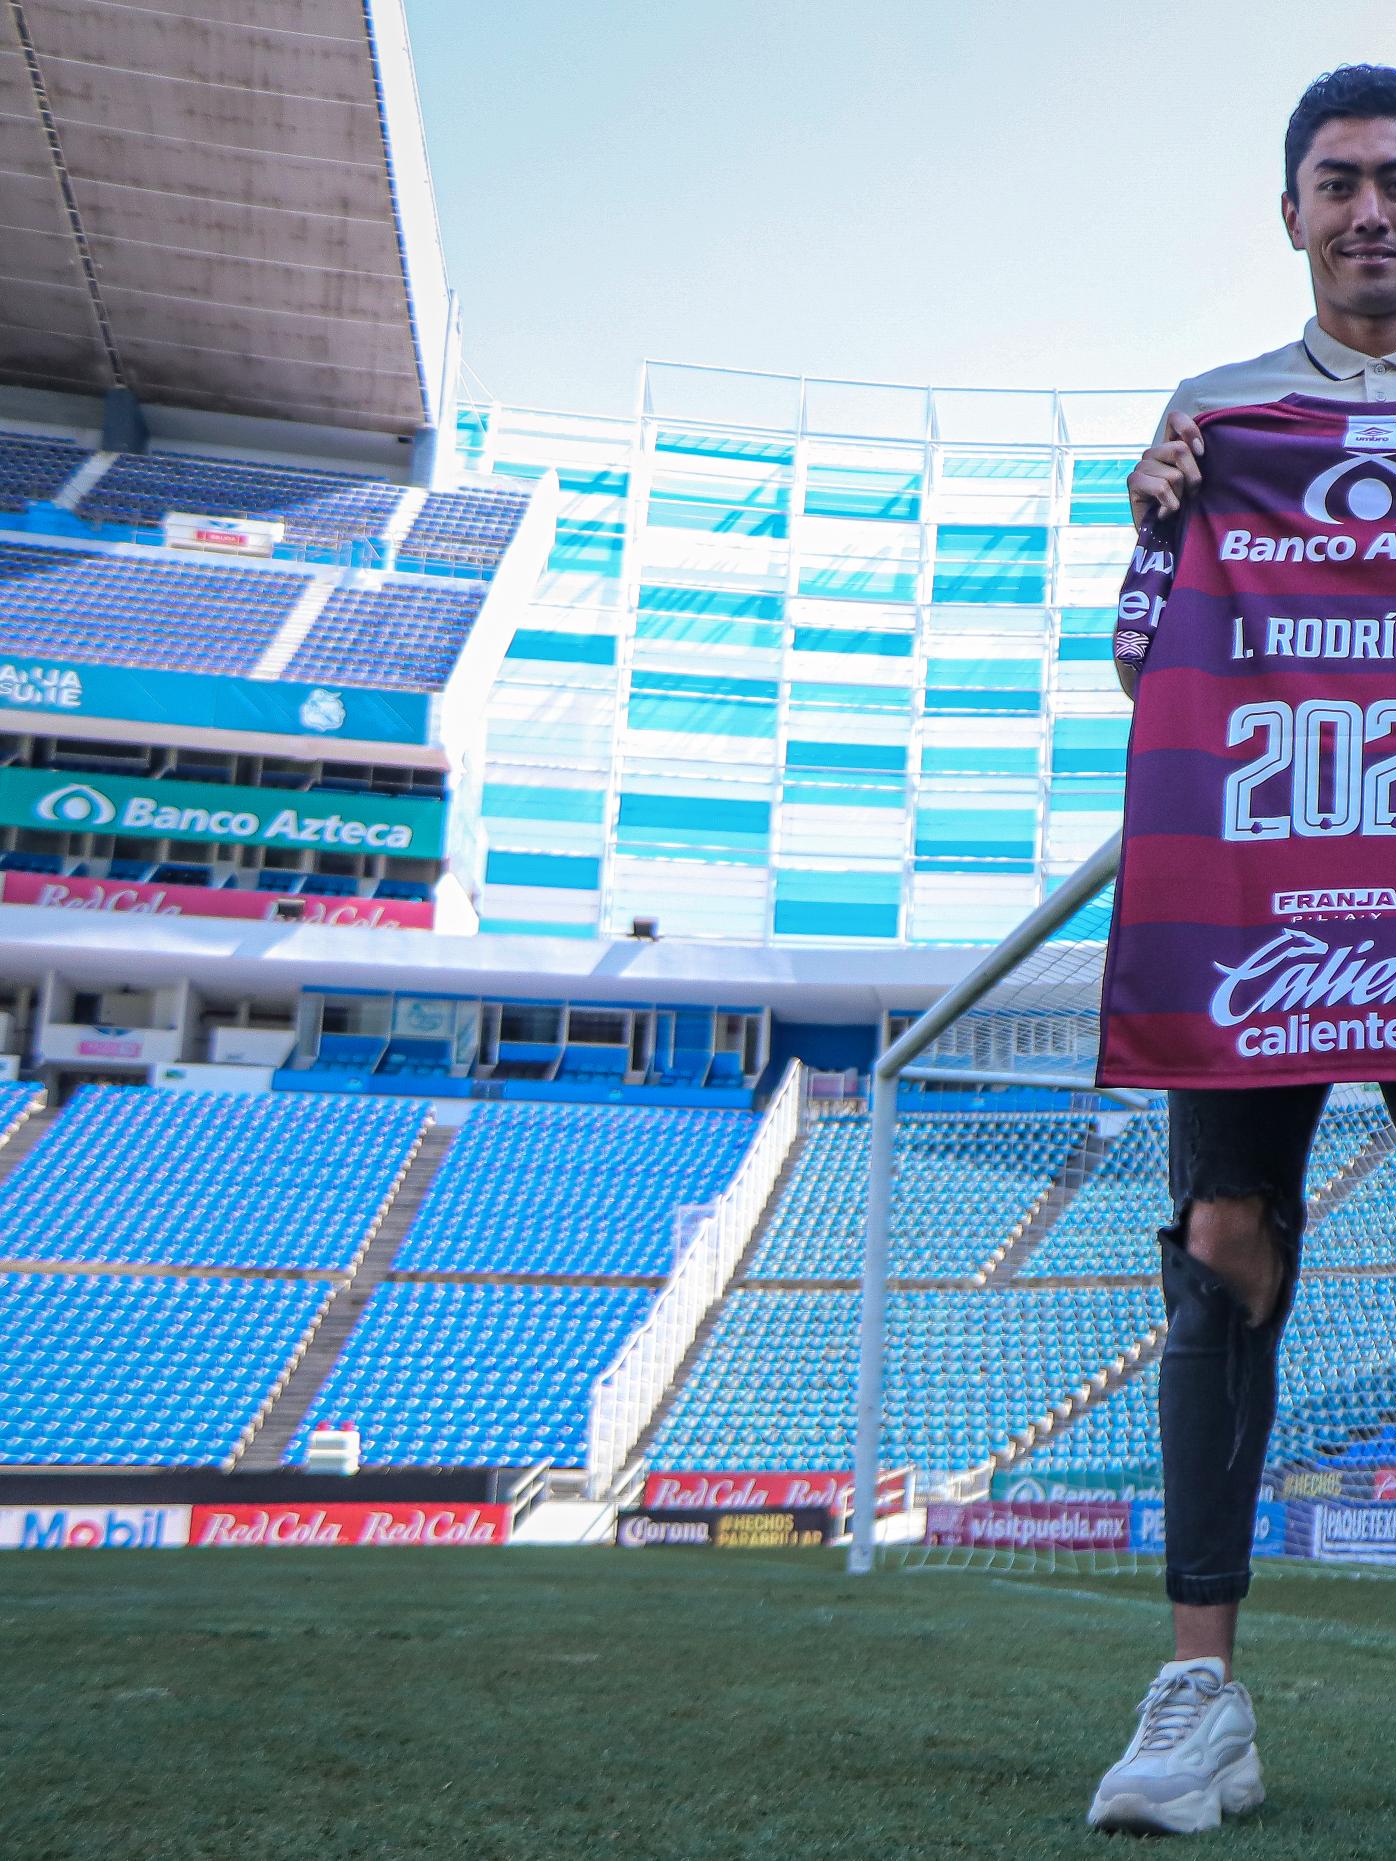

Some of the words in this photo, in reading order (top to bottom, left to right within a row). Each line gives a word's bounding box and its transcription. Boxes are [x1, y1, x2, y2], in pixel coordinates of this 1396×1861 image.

[1220, 529, 1357, 563] Banco
[1231, 616, 1255, 660] I.
[122, 797, 261, 836] Banco
[263, 809, 413, 849] Azteca
[1279, 892, 1395, 910] FRANJA
[20, 1510, 164, 1549] Mobil
[618, 1515, 711, 1545] Corona
[719, 1513, 795, 1532] #HECHOS
[970, 1511, 1126, 1545] visitpuebla.mx
